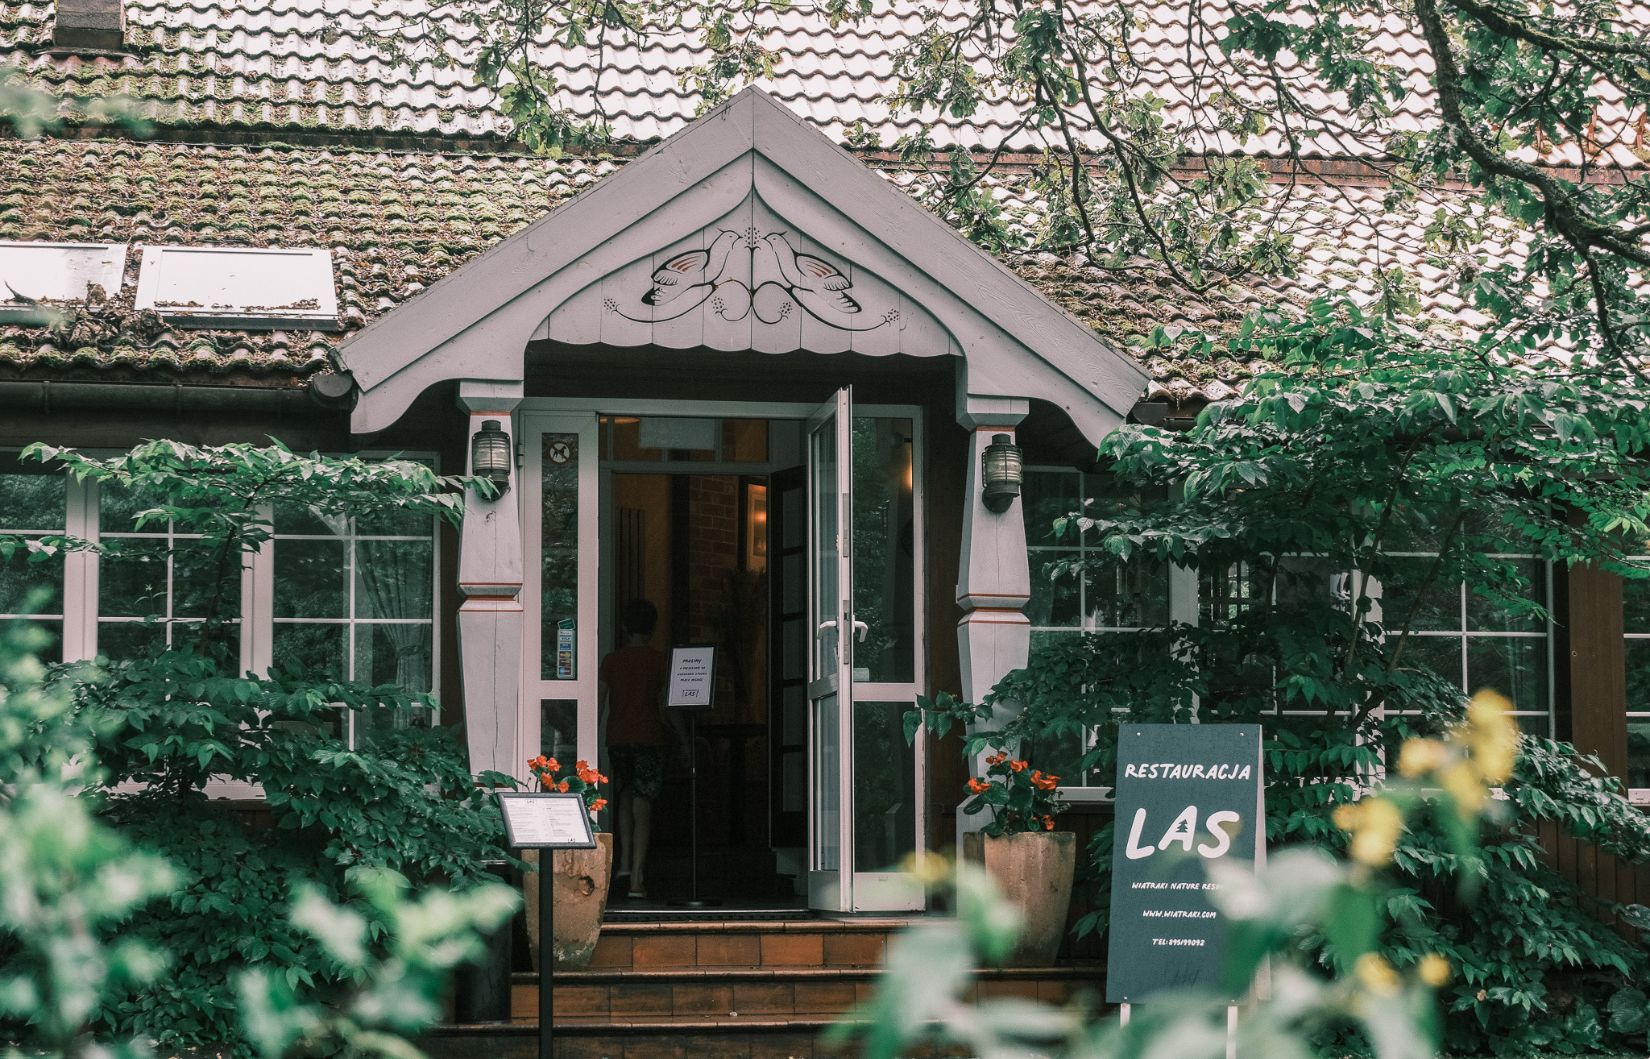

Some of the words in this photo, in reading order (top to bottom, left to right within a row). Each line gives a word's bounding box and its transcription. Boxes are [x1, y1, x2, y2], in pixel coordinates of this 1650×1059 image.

[1124, 763, 1251, 780] RESTAURACJA
[1125, 805, 1240, 860] LAS
[1170, 882, 1200, 890] NATURE
[1142, 910, 1217, 919] WWW.WIATRAKI.COM
